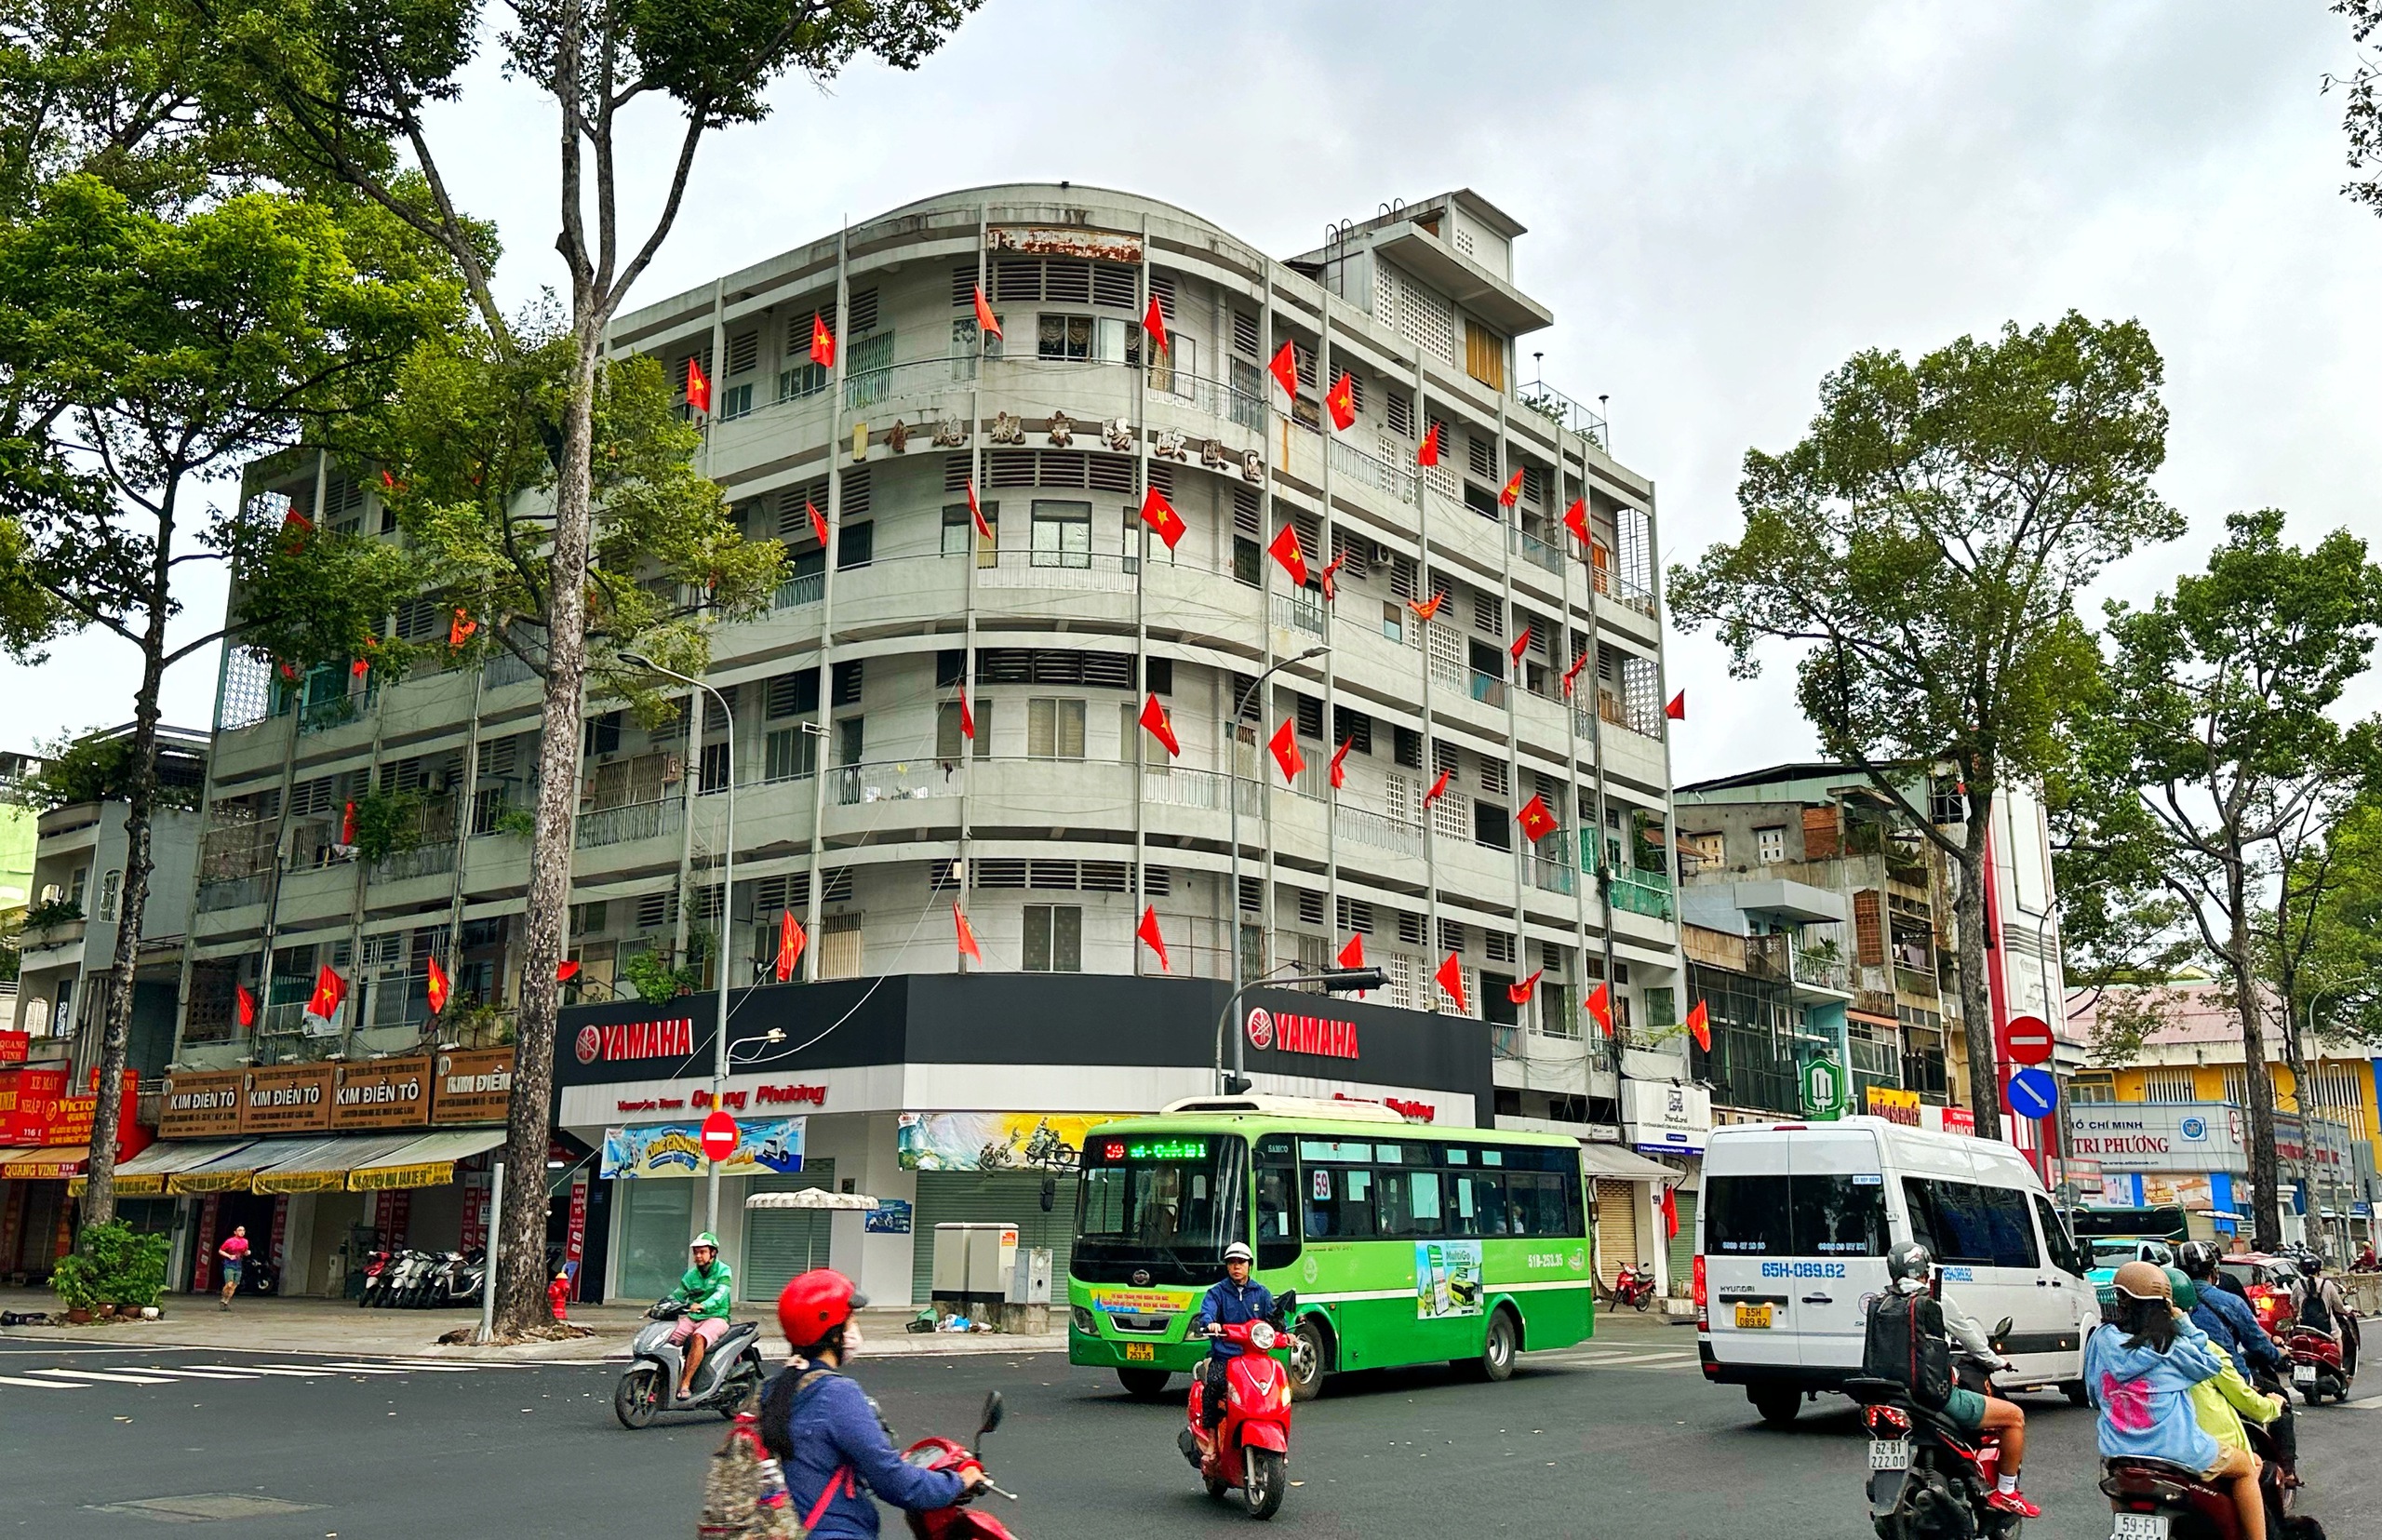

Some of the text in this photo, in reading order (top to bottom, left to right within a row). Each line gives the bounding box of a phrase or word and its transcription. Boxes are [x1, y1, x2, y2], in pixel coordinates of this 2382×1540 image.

[601, 1017, 694, 1061] YAMAHA
[1272, 1011, 1359, 1060] YAMAHA
[336, 1087, 360, 1105] KIM
[399, 1077, 419, 1100] TÔ
[447, 1075, 475, 1093] KIM
[0, 1091, 17, 1110] INH
[170, 1093, 192, 1110] KIM
[220, 1086, 235, 1106] TÔ
[249, 1091, 271, 1107] KIM
[304, 1082, 320, 1104] TÔ
[691, 1088, 750, 1109] Qung
[60, 1099, 97, 1112] VICTO
[2089, 1120, 2109, 1130] CHÍ
[2112, 1121, 2143, 1130] MINH
[2073, 1134, 2170, 1154] TRI PHƯƠNG
[5, 1164, 37, 1177] QUANG
[38, 1163, 60, 1176] VINH
[1315, 1172, 1329, 1197] 59
[1761, 1262, 1846, 1279] 65H-089.82
[1746, 1307, 1761, 1317] 65H
[1739, 1318, 1768, 1327] 089.82
[1875, 1442, 1901, 1454] 62-B1
[2122, 1517, 2158, 1534] 59-F1
